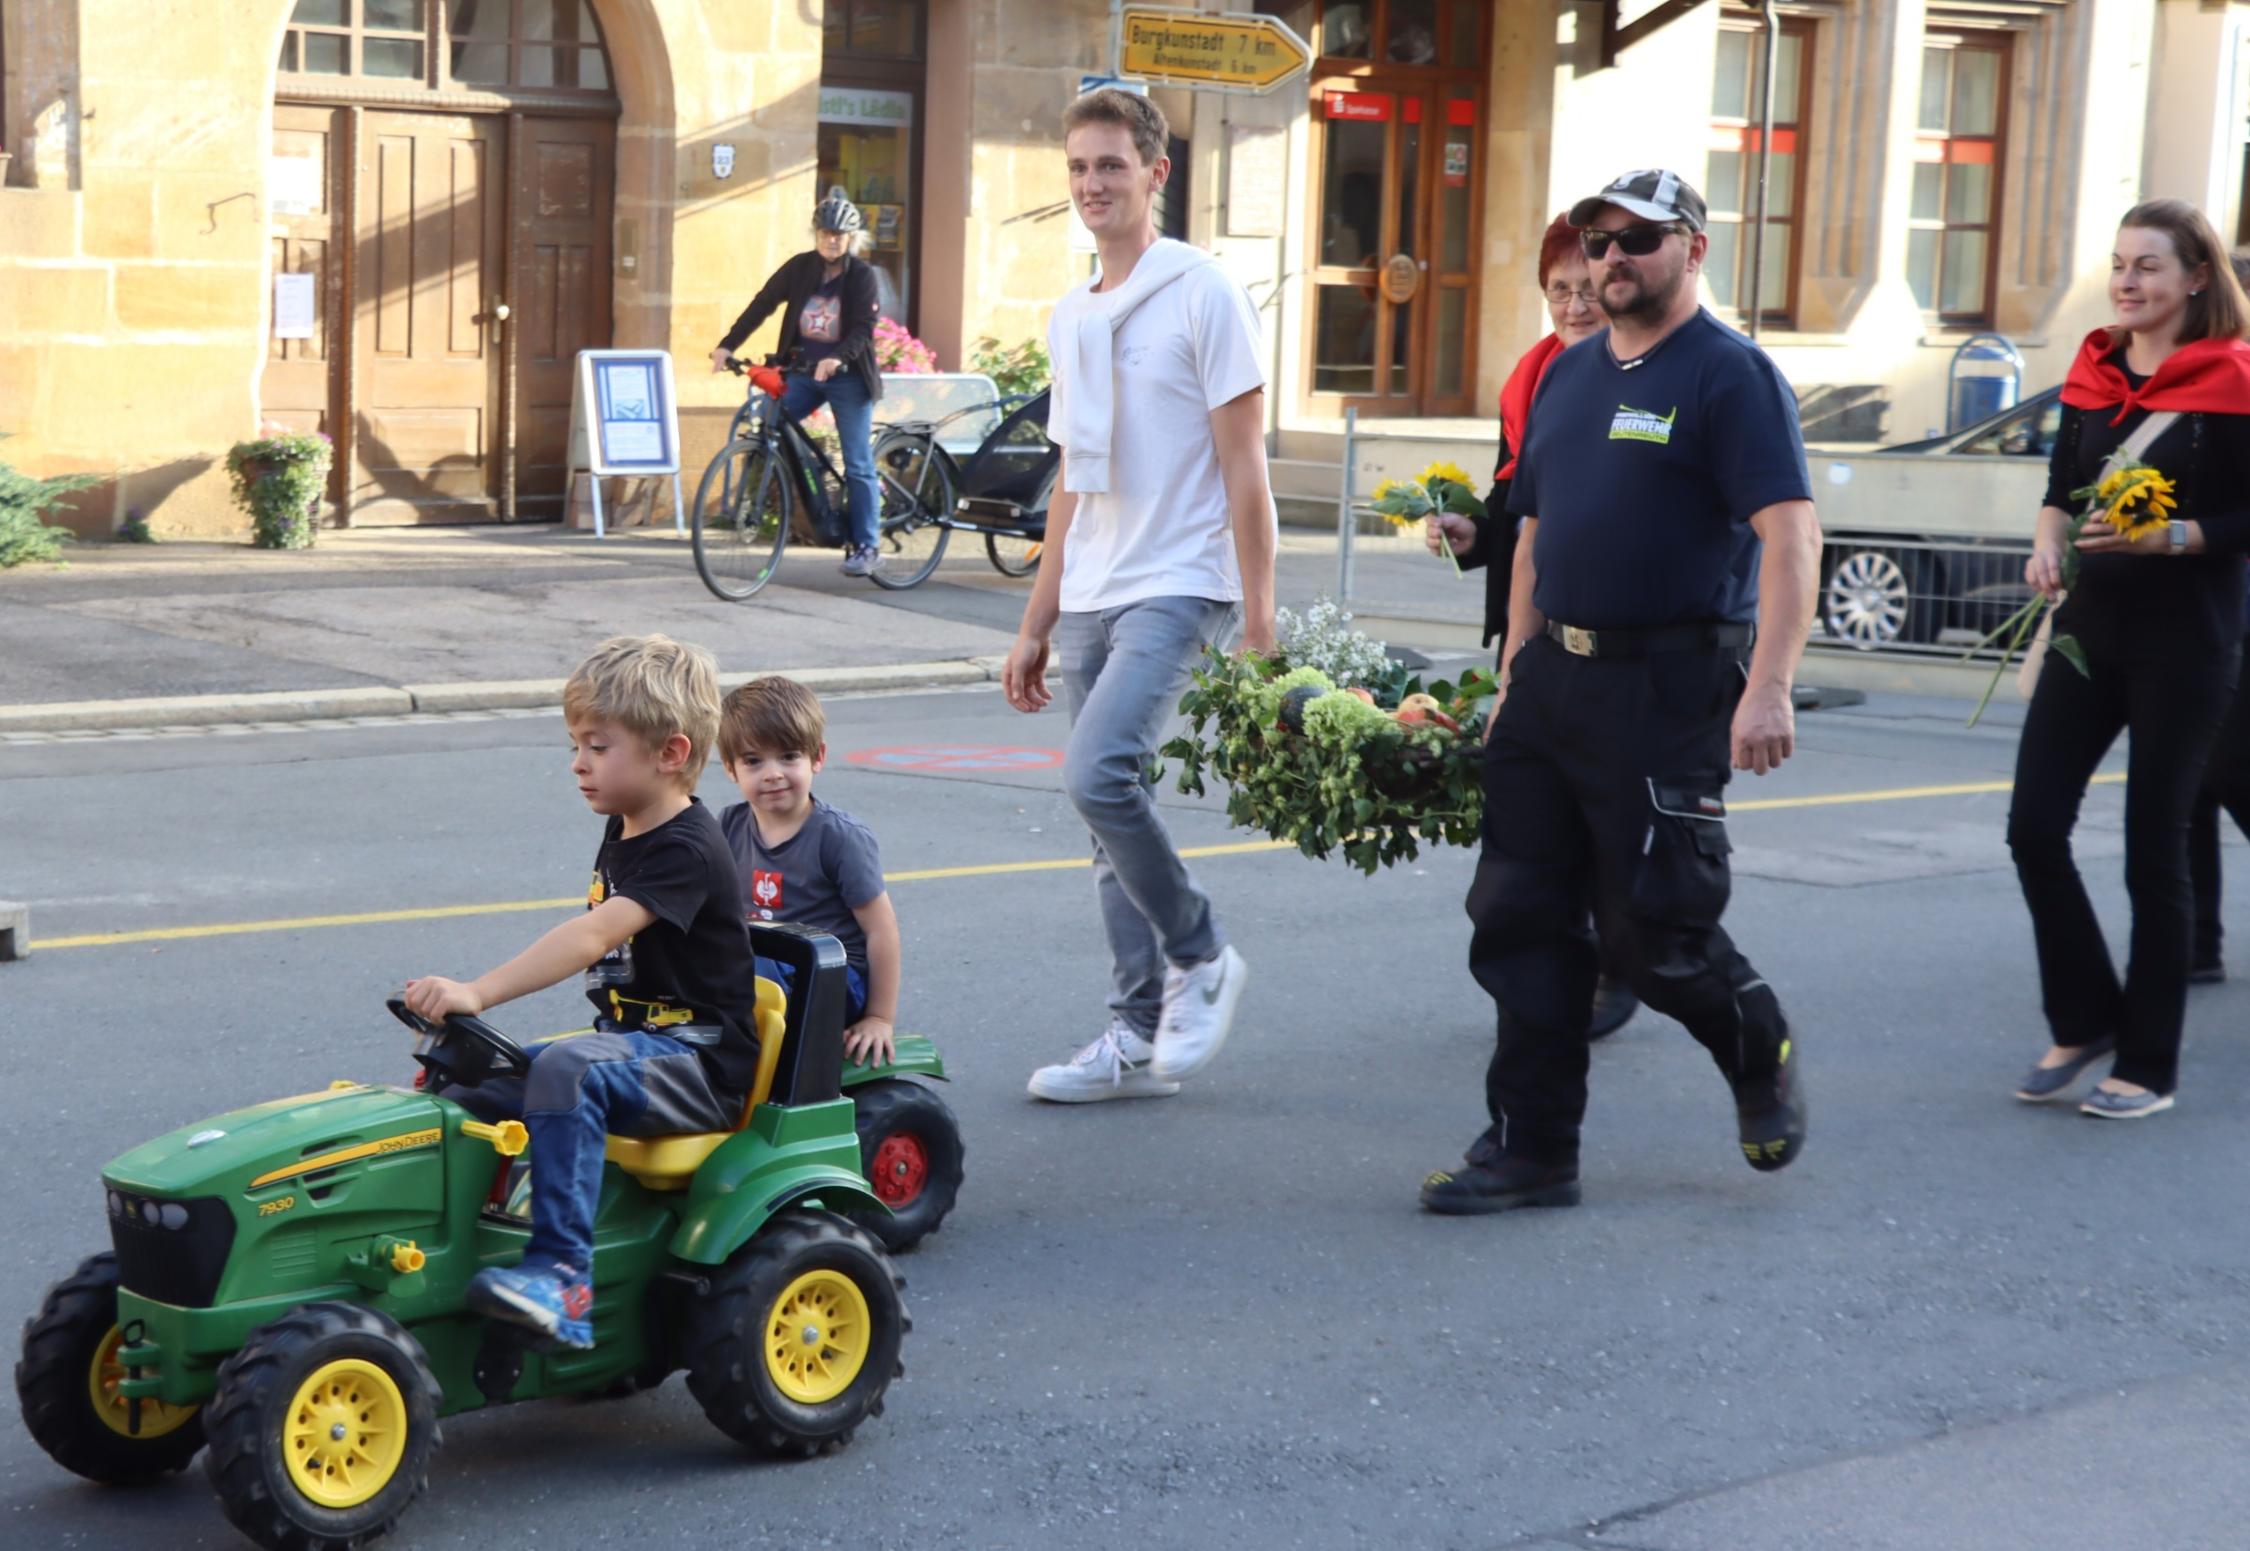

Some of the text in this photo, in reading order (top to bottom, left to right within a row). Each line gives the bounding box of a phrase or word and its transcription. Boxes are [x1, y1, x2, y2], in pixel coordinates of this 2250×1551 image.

[1132, 25, 1277, 55] Burgkunstadt 7 km
[378, 1132, 439, 1153] JOHN DEERE
[258, 1197, 295, 1217] 7930
